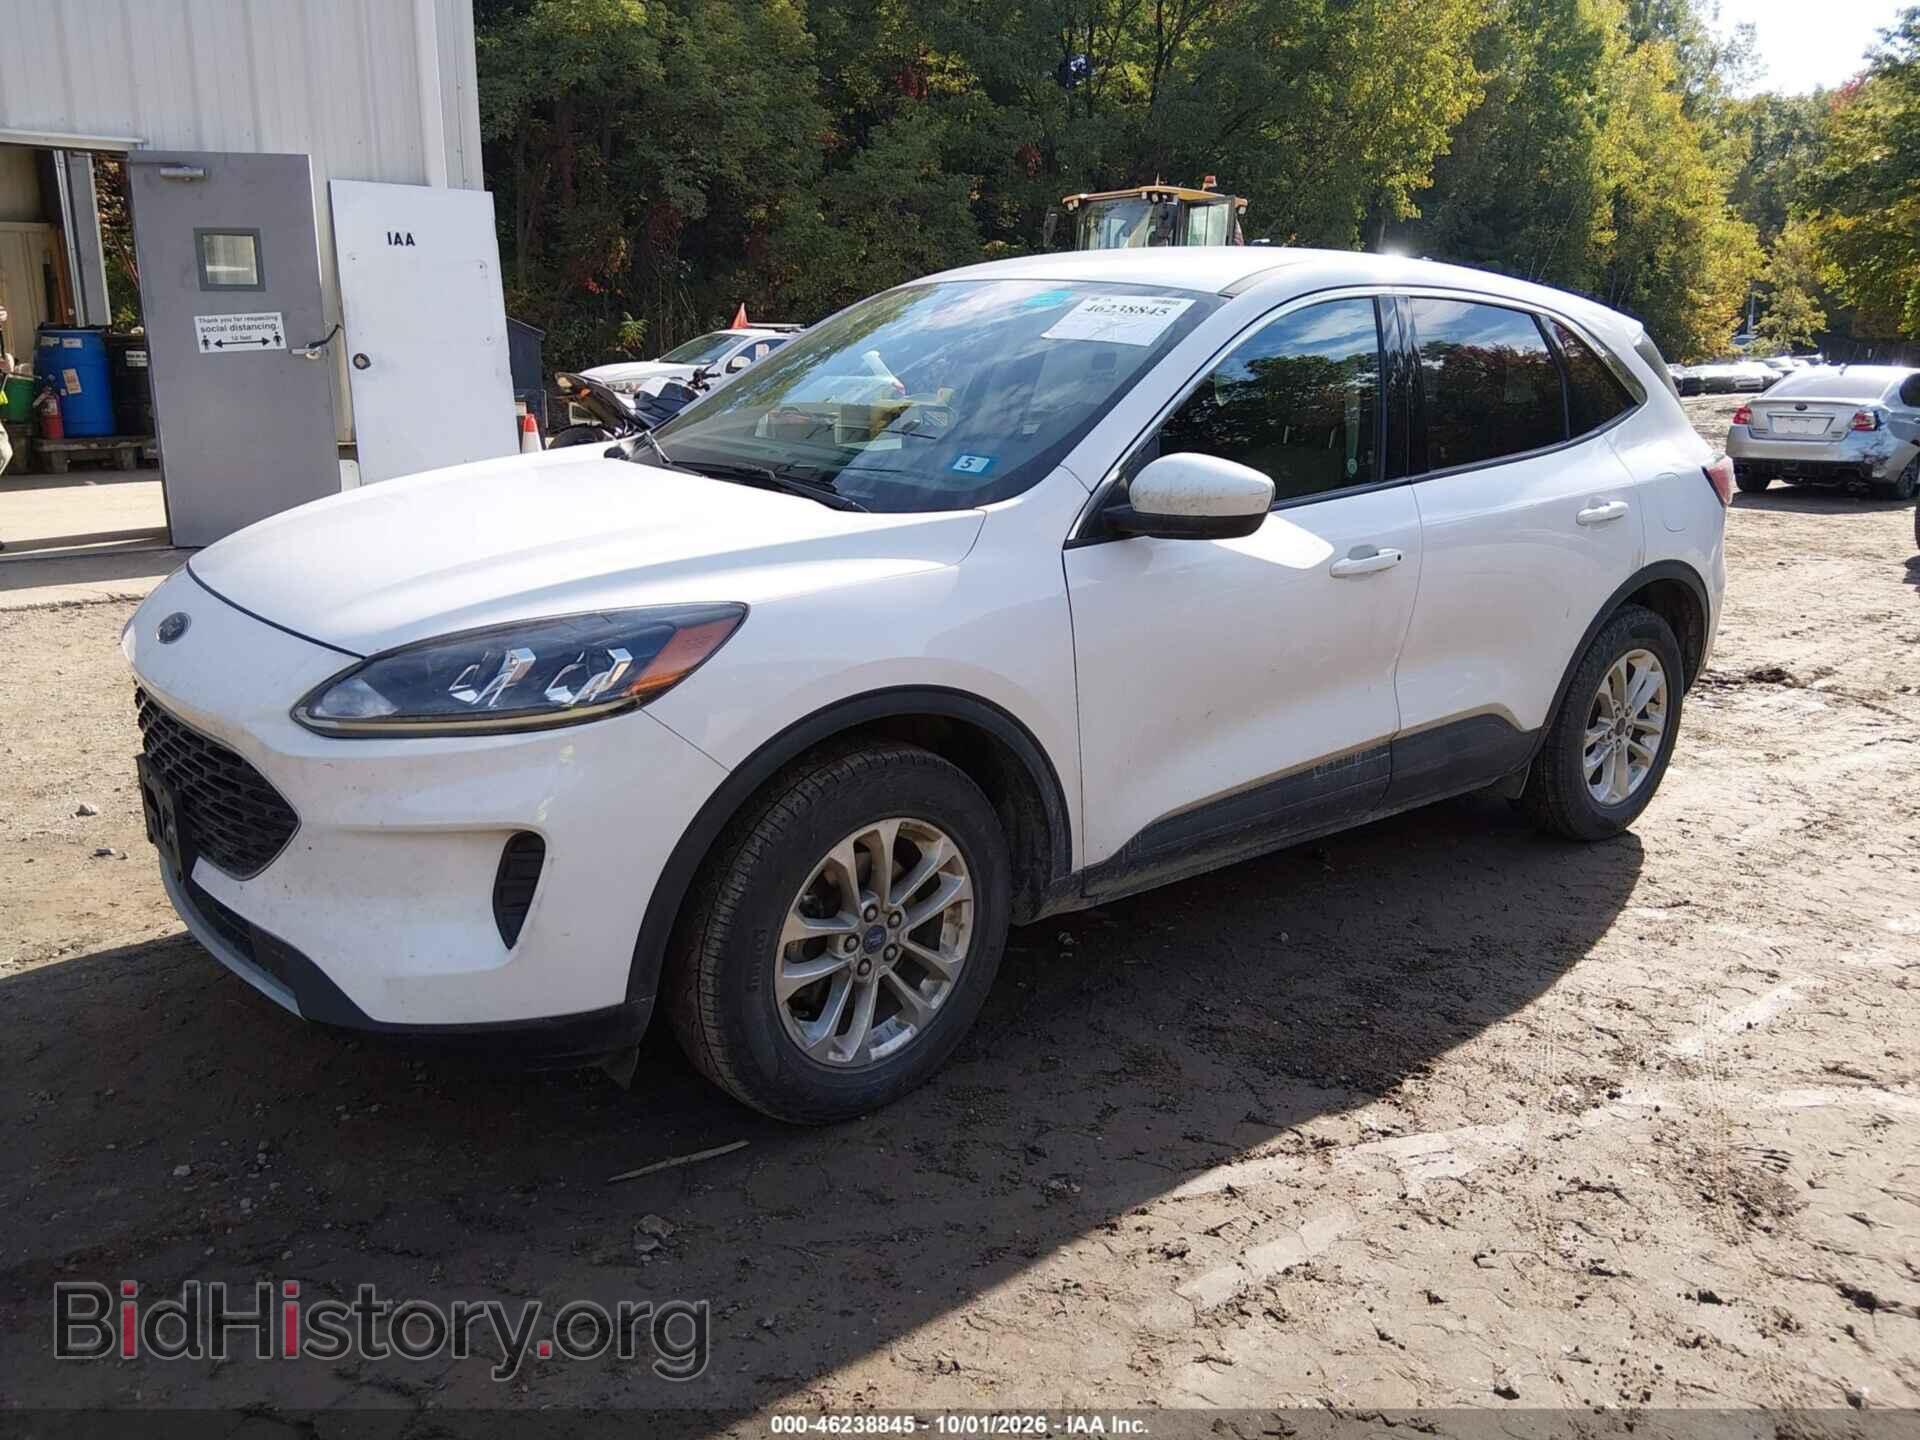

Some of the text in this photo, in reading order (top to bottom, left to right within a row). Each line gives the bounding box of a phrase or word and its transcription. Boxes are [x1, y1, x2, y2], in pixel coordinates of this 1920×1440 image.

[387, 231, 416, 246] IAA
[1085, 304, 1171, 316] 46238845
[200, 325, 227, 333] social
[961, 457, 976, 469] 5
